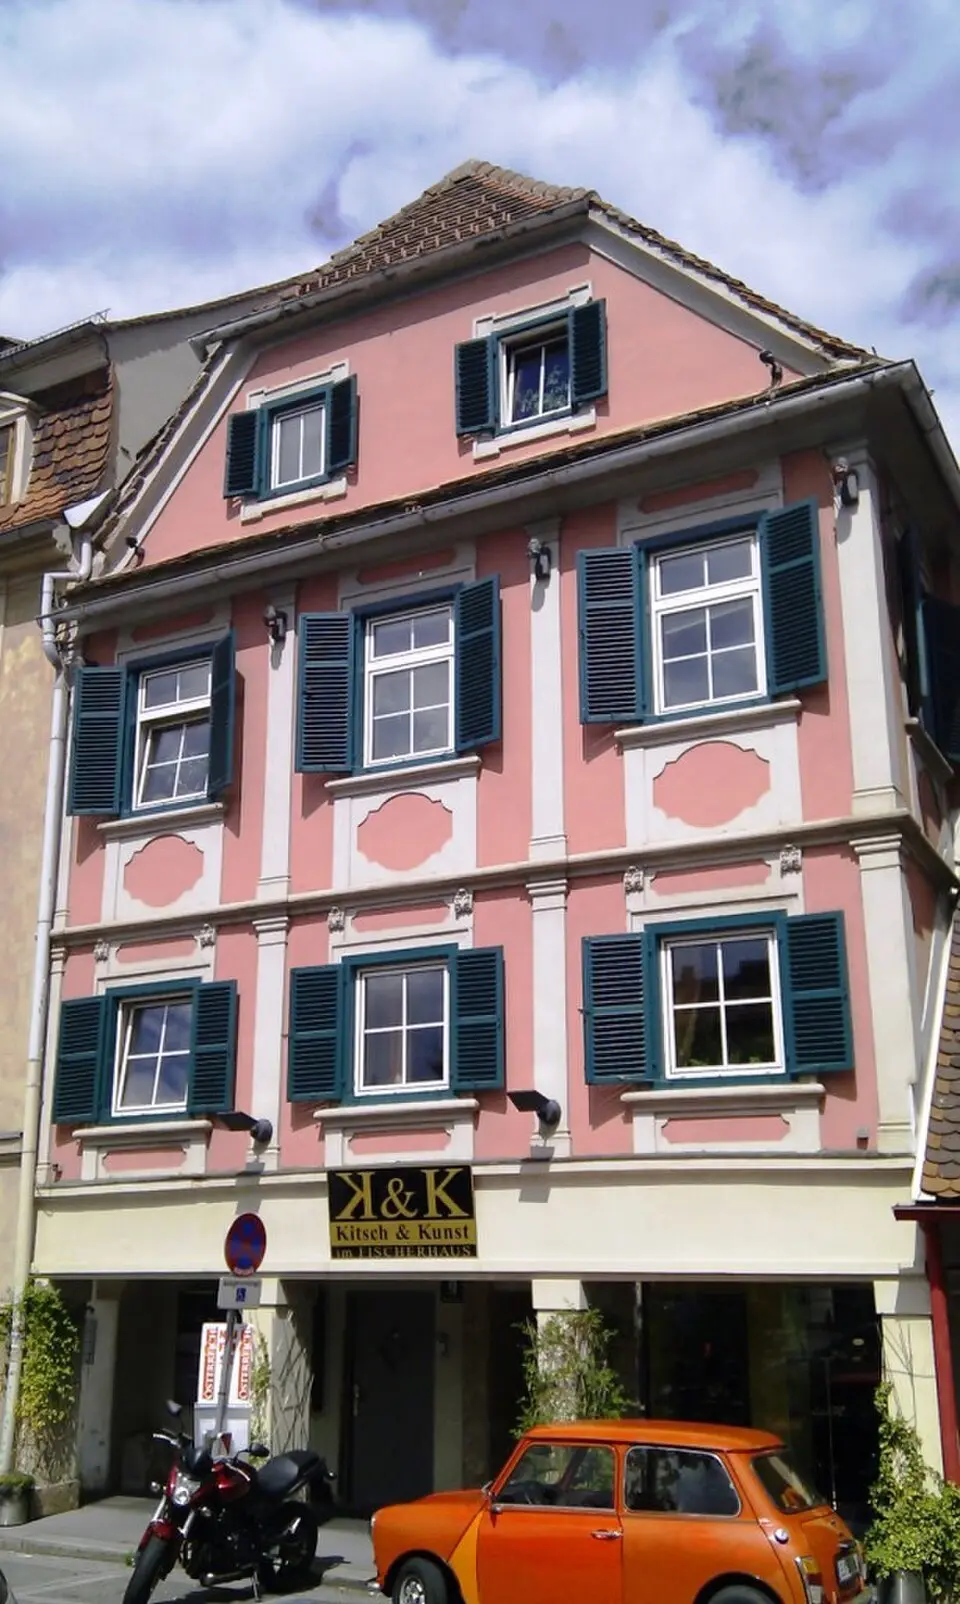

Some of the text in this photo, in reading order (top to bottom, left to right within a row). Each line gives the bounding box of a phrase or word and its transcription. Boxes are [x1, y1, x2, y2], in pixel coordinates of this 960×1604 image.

[336, 1224, 469, 1241] Kitsch & Kunst
[358, 1246, 471, 1259] FISCHERHAUS
